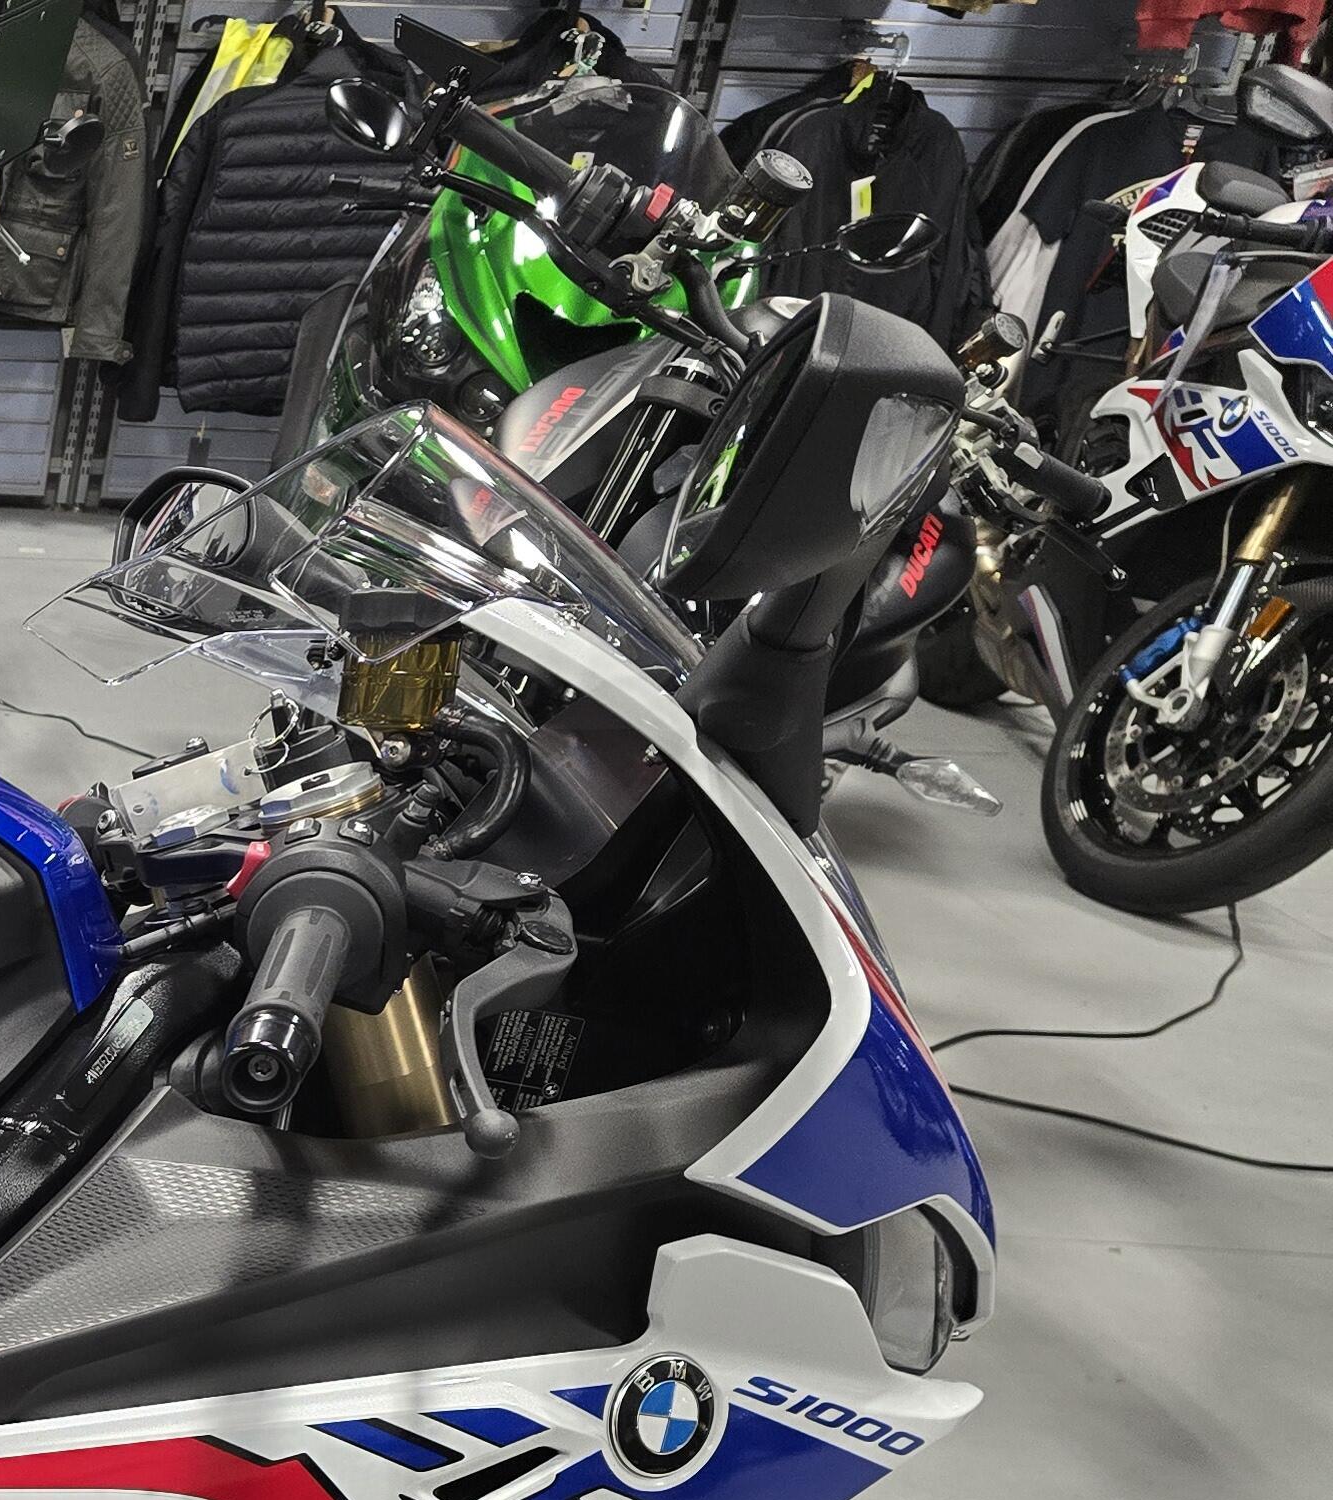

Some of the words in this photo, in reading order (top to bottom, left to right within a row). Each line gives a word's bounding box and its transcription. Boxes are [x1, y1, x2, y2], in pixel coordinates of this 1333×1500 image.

[519, 387, 587, 453] DUCATI
[1254, 410, 1299, 458] S1000
[900, 512, 943, 599] DUCATI
[634, 1360, 714, 1402] BMW
[733, 1376, 925, 1456] S1000
